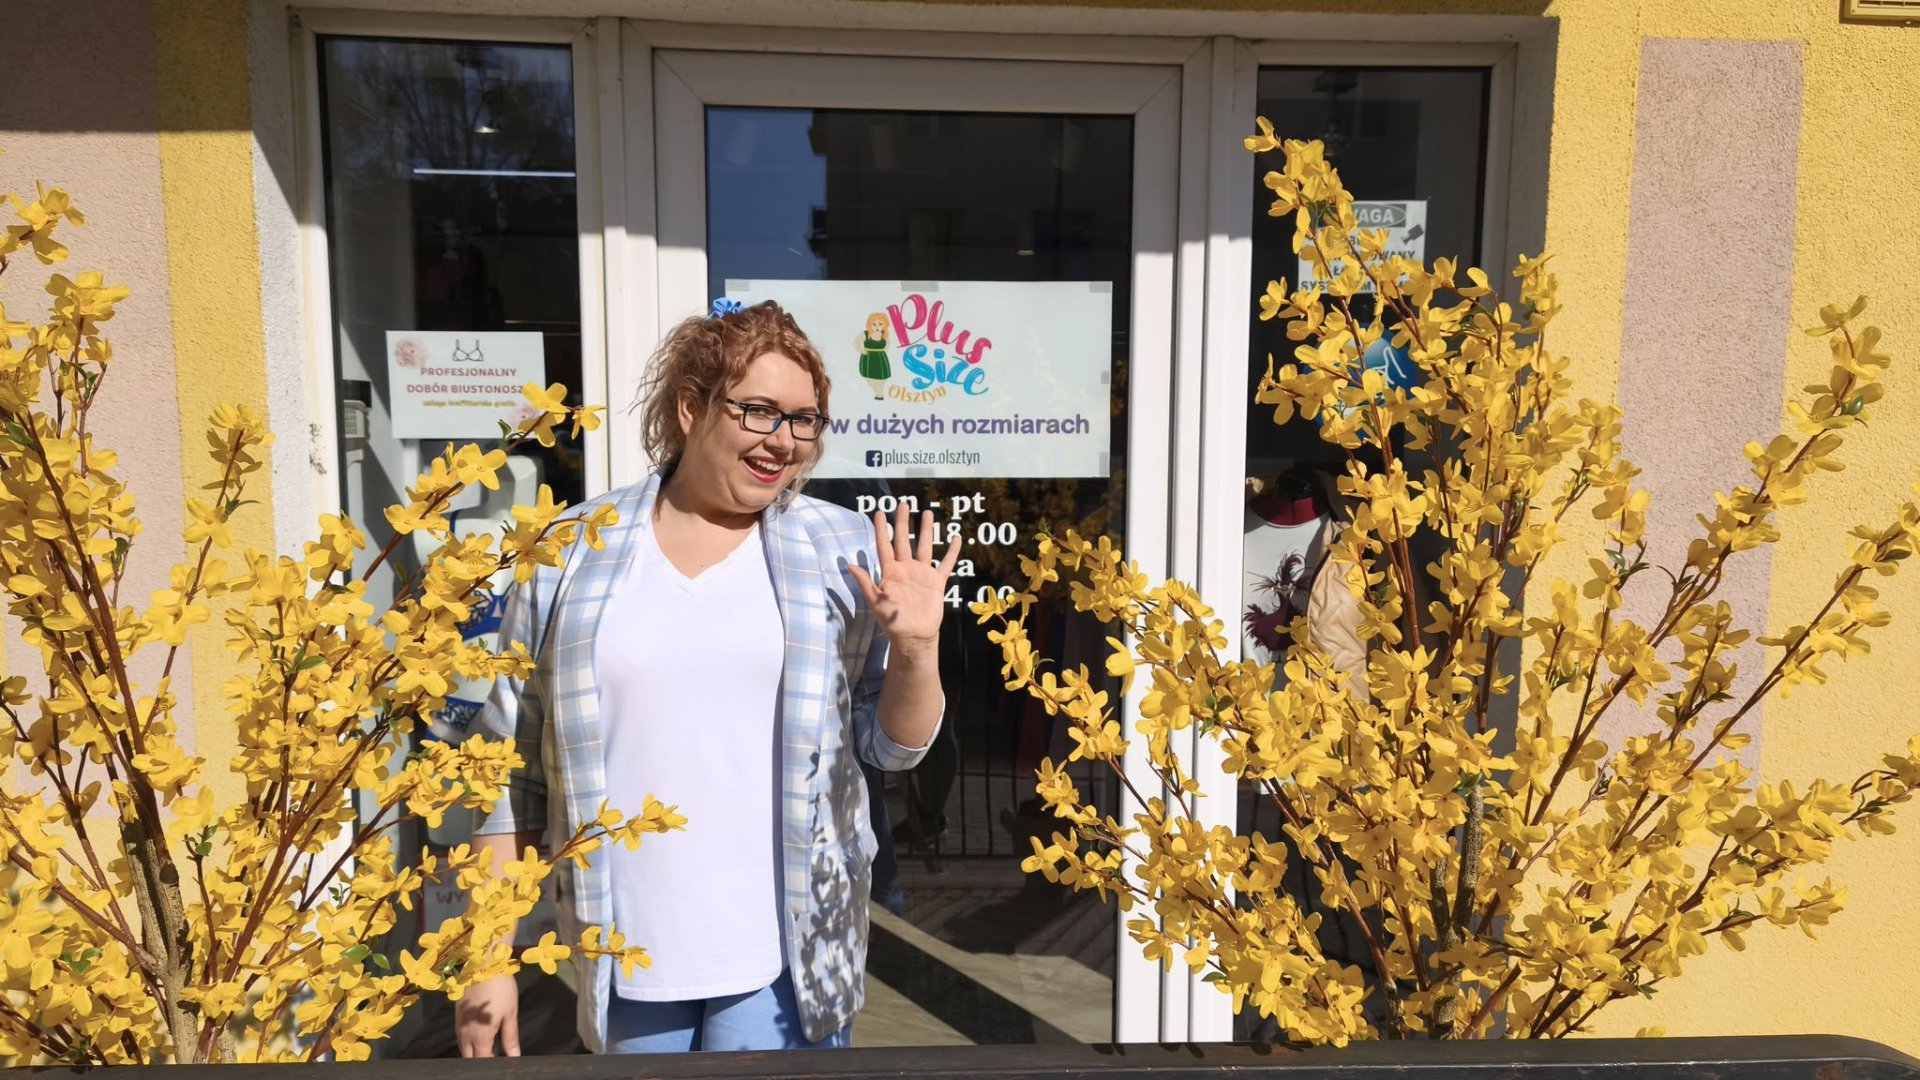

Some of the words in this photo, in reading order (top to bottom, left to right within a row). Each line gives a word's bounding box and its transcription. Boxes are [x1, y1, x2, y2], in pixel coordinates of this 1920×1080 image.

[886, 294, 992, 364] Plus
[420, 367, 517, 377] PROFESJONALNY
[902, 344, 989, 396] Size
[406, 382, 448, 394] DOBÓR
[451, 384, 524, 394] BIUSTONOSZ
[888, 384, 947, 405] Olsztyn
[830, 418, 850, 434] w
[857, 413, 945, 440] dużych
[952, 413, 1090, 435] rozmiarach
[885, 449, 980, 467] plus.size.olsztyn
[856, 494, 919, 514] pon
[951, 491, 986, 520] pt
[932, 521, 1018, 546] 18.00
